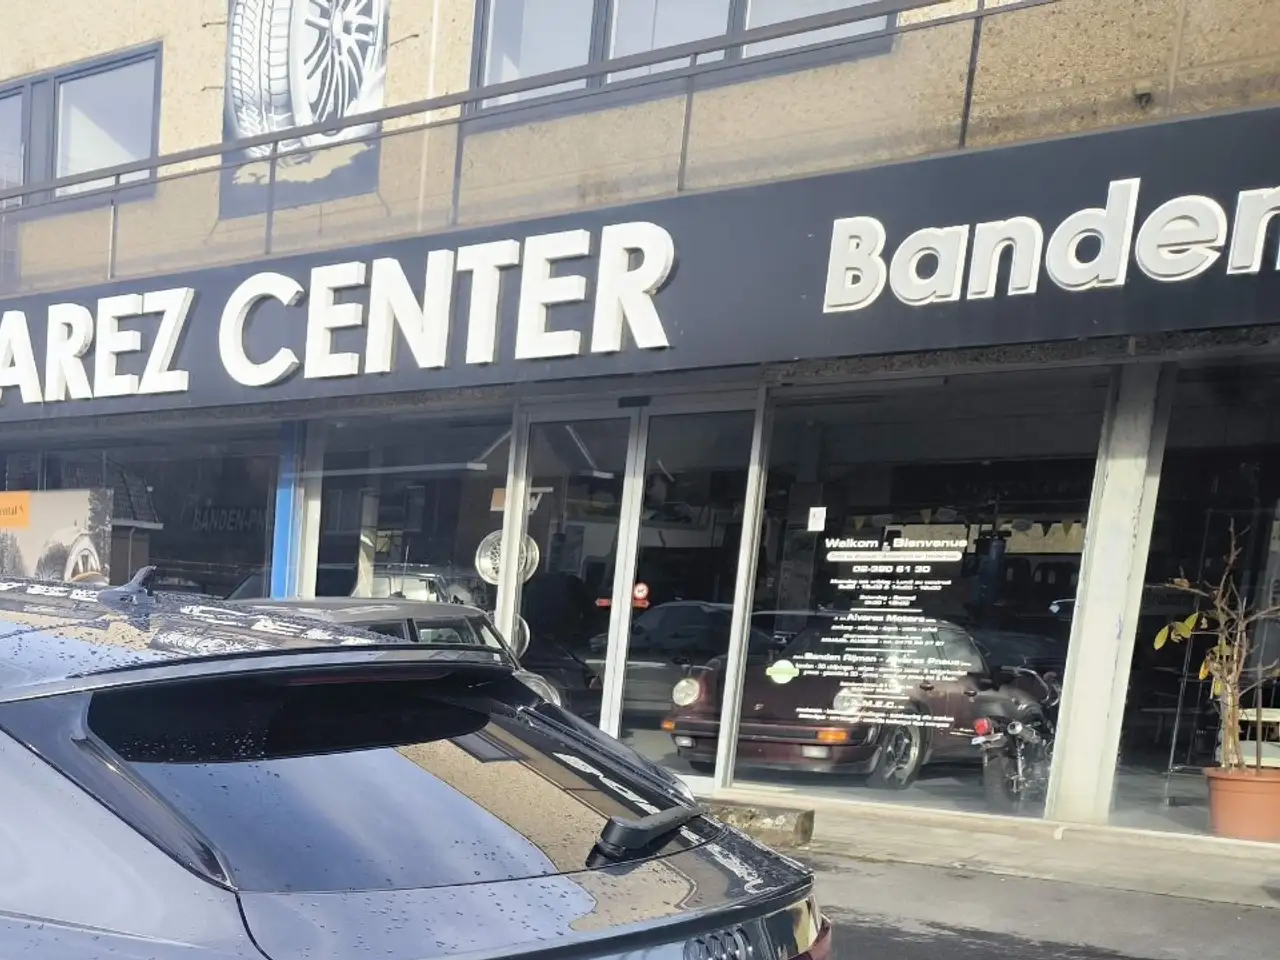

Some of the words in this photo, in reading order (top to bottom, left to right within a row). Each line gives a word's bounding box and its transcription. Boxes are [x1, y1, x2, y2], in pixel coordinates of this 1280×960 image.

[218, 221, 676, 387] CENTER
[825, 538, 879, 548] Welkom
[892, 537, 968, 548] Bienvenue
